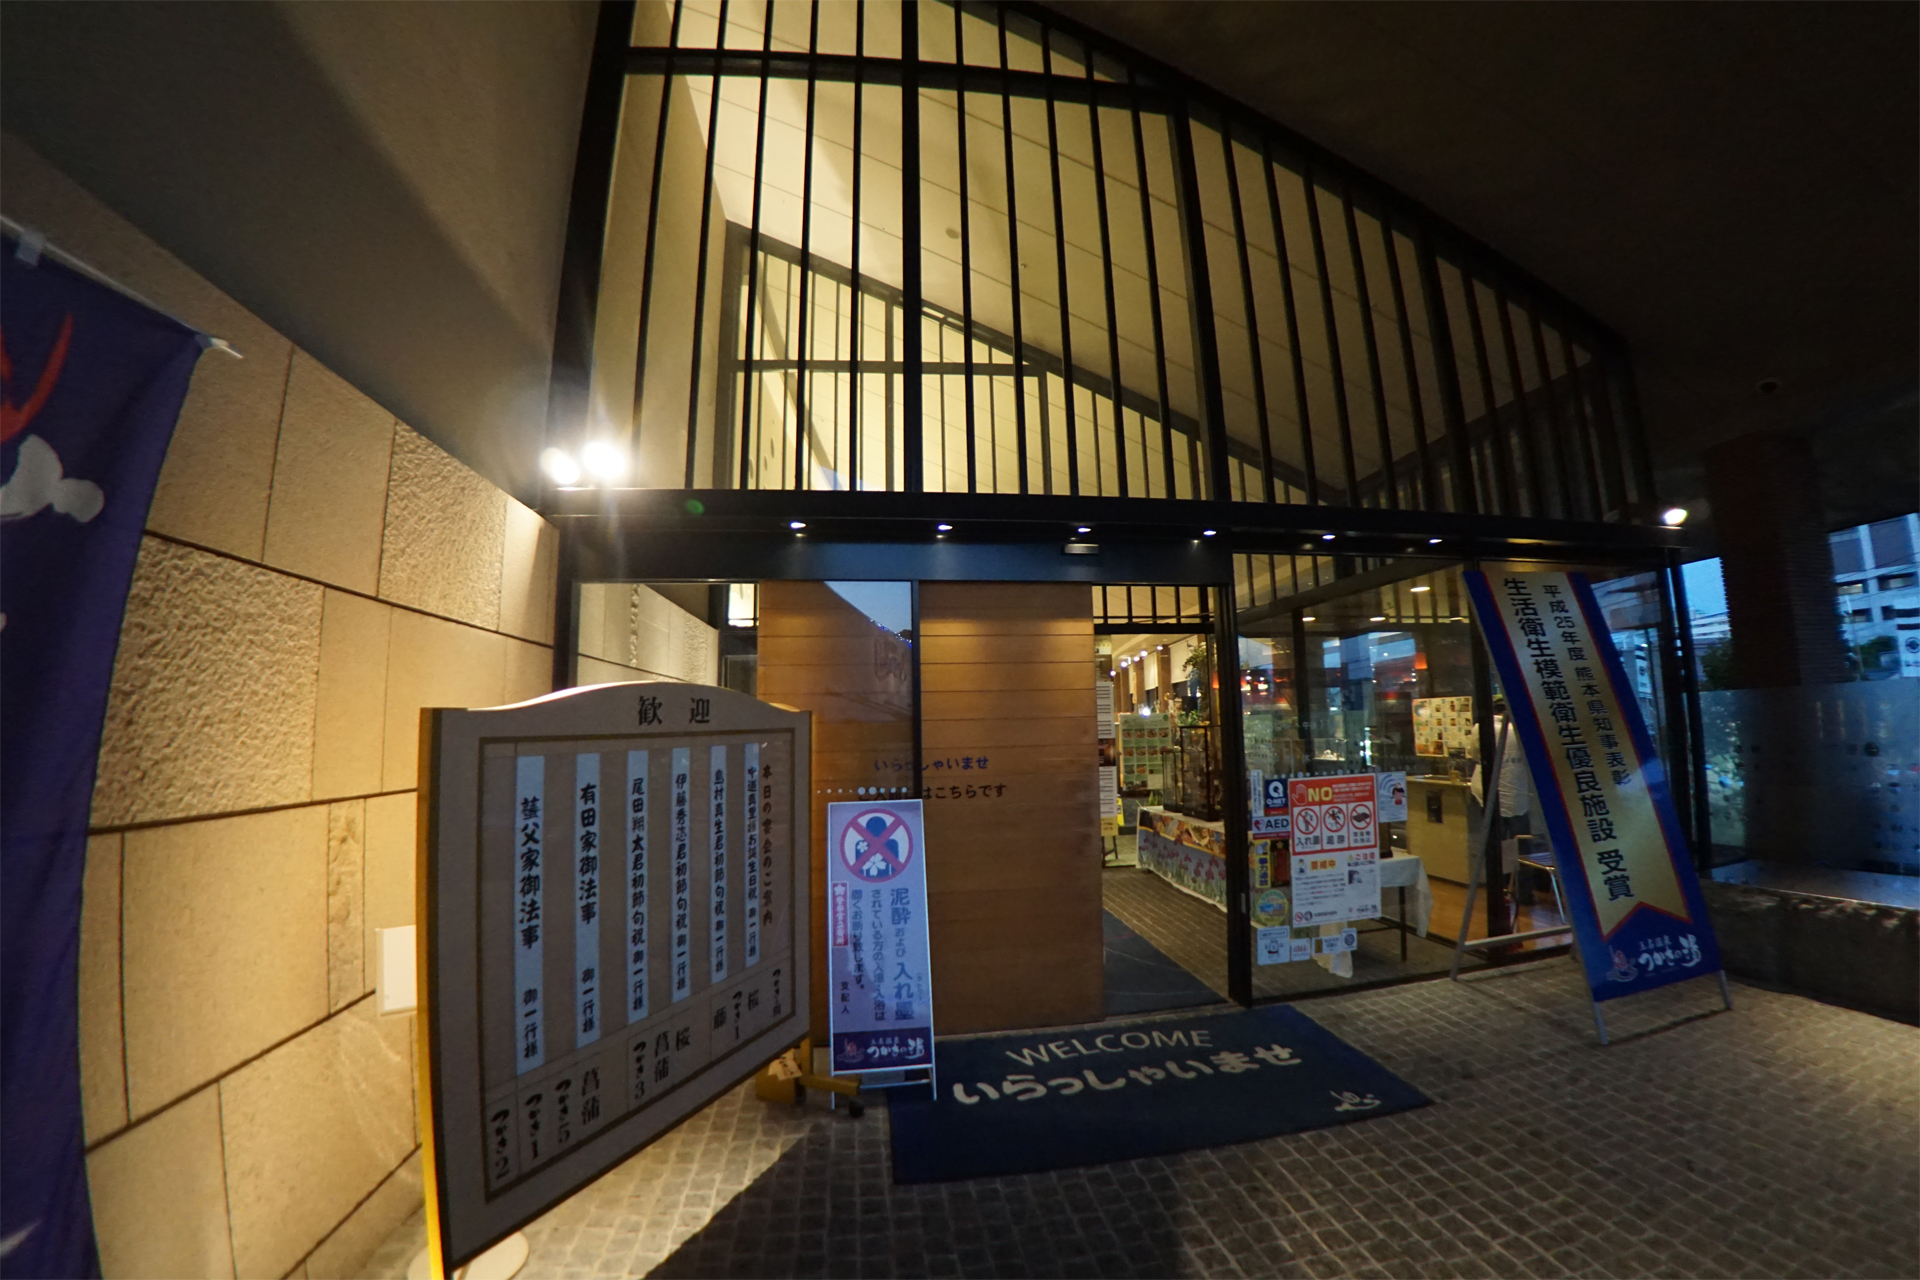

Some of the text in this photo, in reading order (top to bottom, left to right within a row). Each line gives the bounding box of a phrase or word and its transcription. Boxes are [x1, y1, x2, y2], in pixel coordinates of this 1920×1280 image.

[1541, 584, 1631, 786] 平成25年度 熊本県知事表彰
[638, 696, 710, 726] 歓迎
[1503, 577, 1635, 901] 生活衛生模範衛生優良施設 受賞
[1307, 786, 1333, 803] NO
[1265, 819, 1289, 829] AED
[579, 783, 597, 925] 有田家御法事
[1005, 1029, 1213, 1068] WELCOME
[953, 1044, 1302, 1104] いらっしゃいませ
